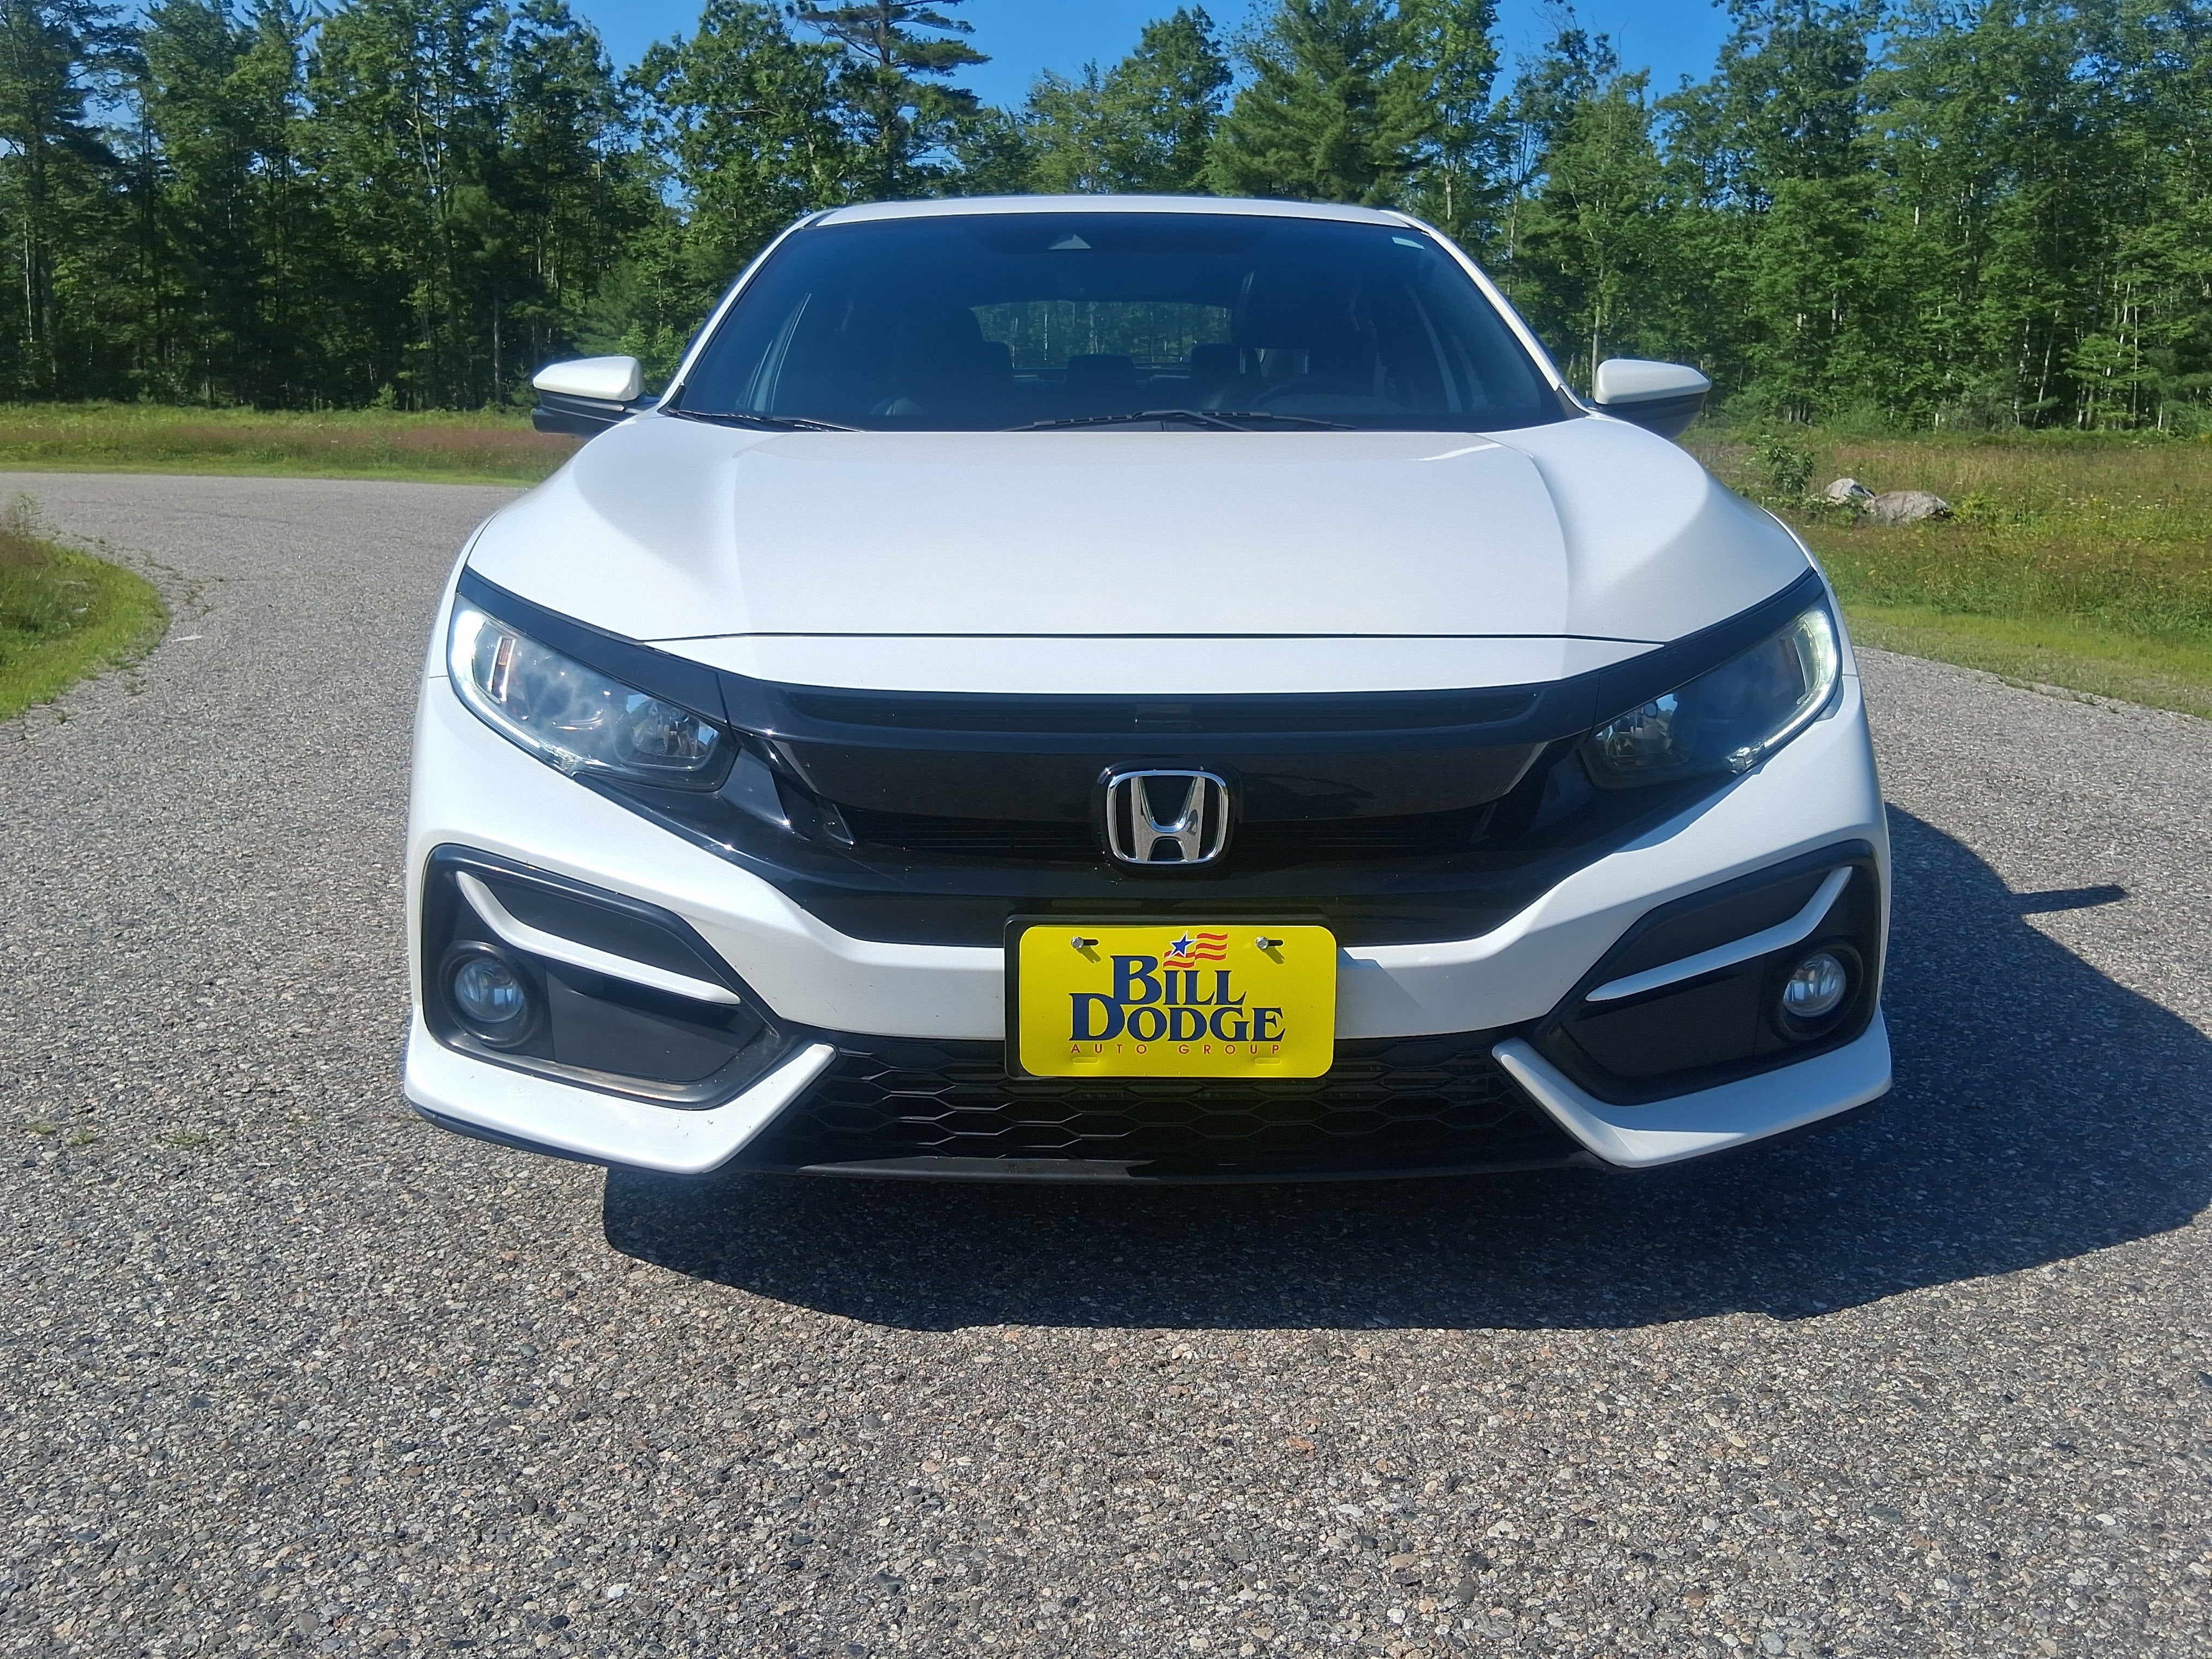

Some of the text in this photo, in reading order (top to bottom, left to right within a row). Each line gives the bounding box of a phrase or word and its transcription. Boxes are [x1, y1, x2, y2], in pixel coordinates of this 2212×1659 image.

[1110, 955, 1246, 1005] BILL
[1069, 993, 1285, 1042] DODGE
[1071, 1044, 1279, 1054] AUTO GROUP
